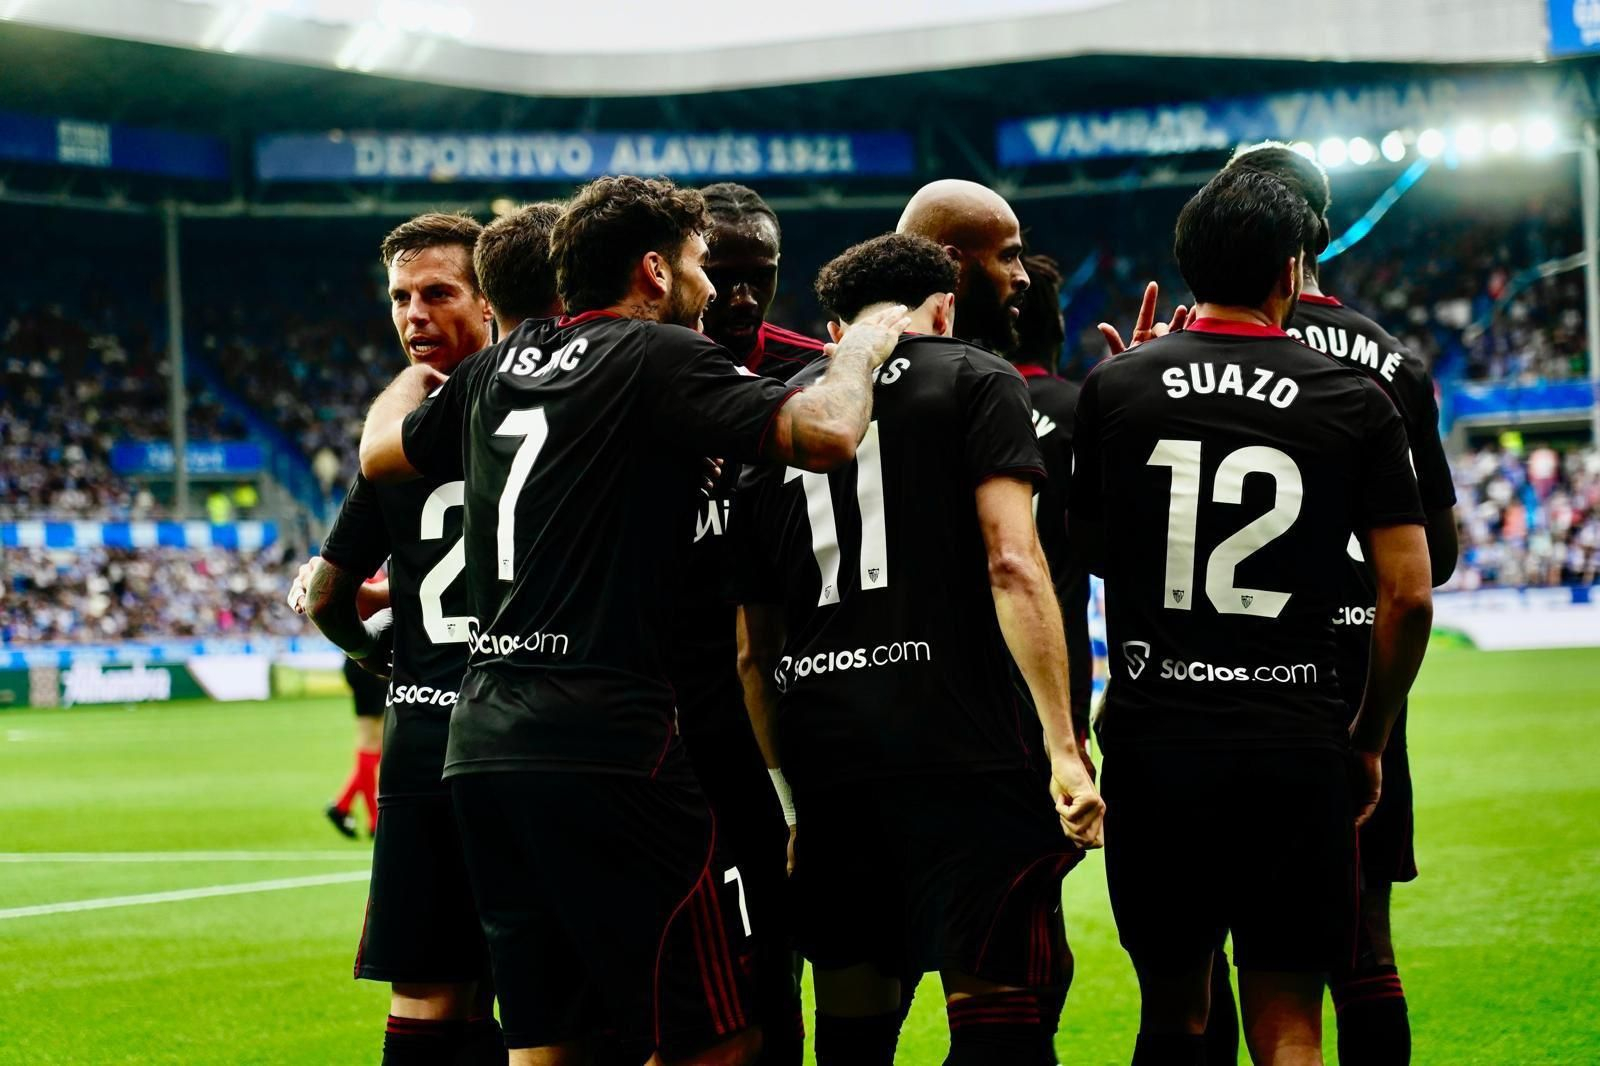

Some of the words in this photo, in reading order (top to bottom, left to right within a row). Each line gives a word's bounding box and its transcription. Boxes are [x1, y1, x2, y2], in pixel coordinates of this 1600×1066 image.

[1162, 363, 1299, 409] SUAZO
[493, 405, 549, 582] 7
[1146, 439, 1303, 618] 12
